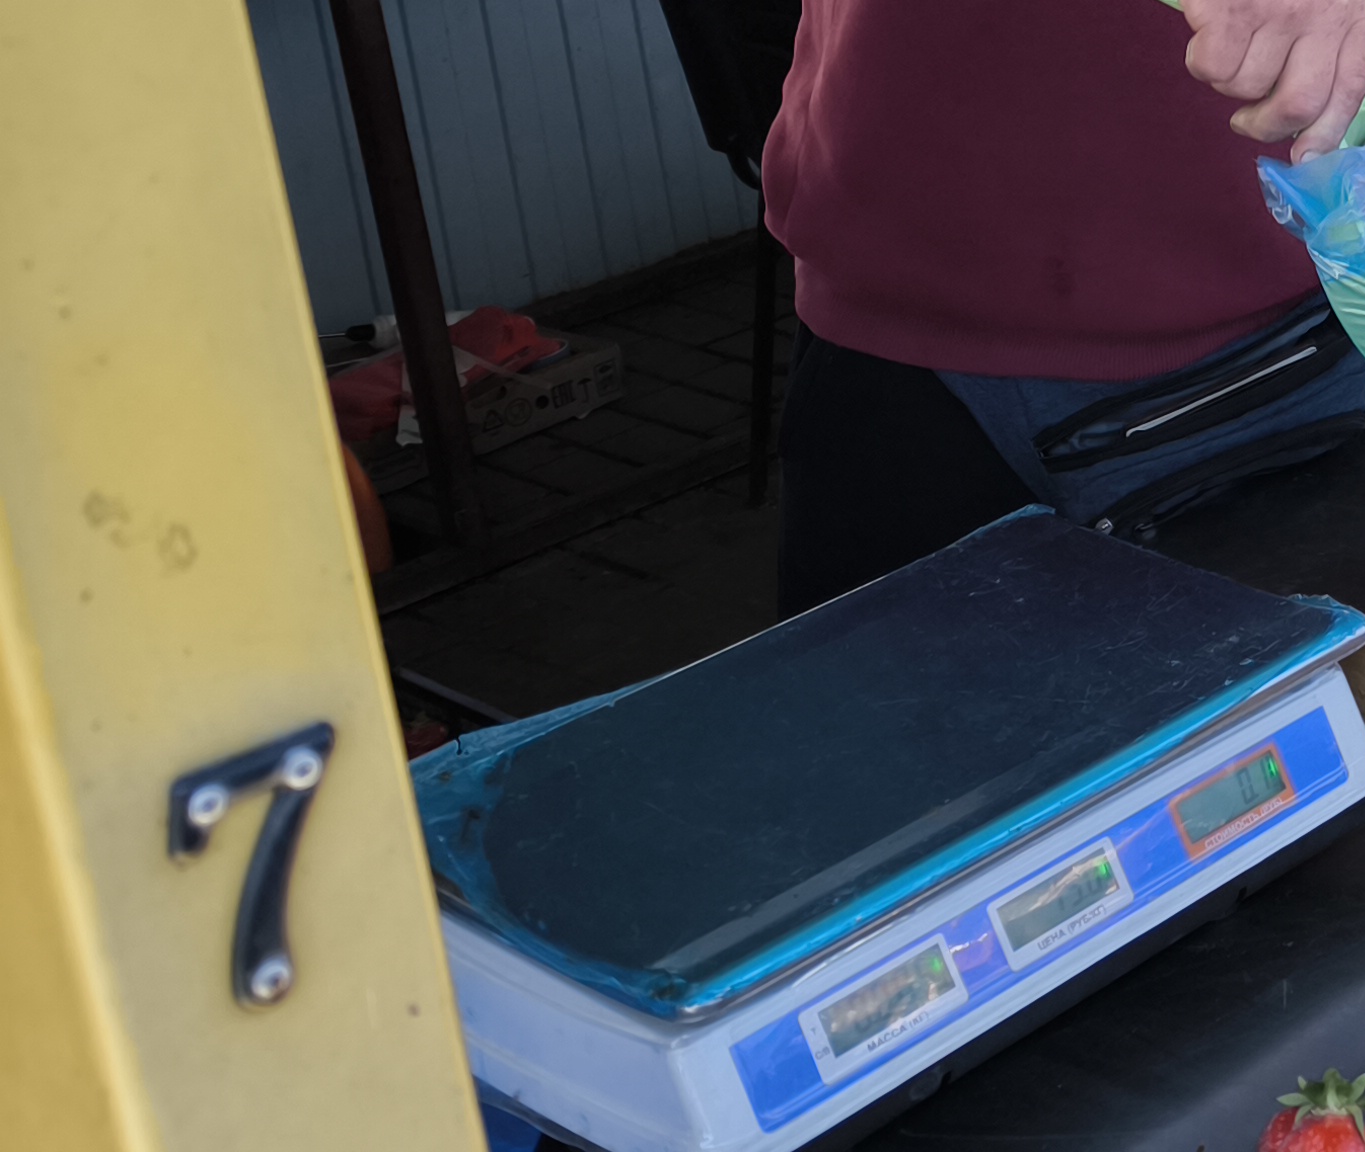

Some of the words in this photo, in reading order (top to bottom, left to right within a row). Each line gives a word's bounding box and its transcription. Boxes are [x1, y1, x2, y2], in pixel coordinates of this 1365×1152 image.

[167, 721, 336, 1015] 7
[1036, 928, 1066, 951] ЦЕНА
[866, 1025, 908, 1053] МАССА
